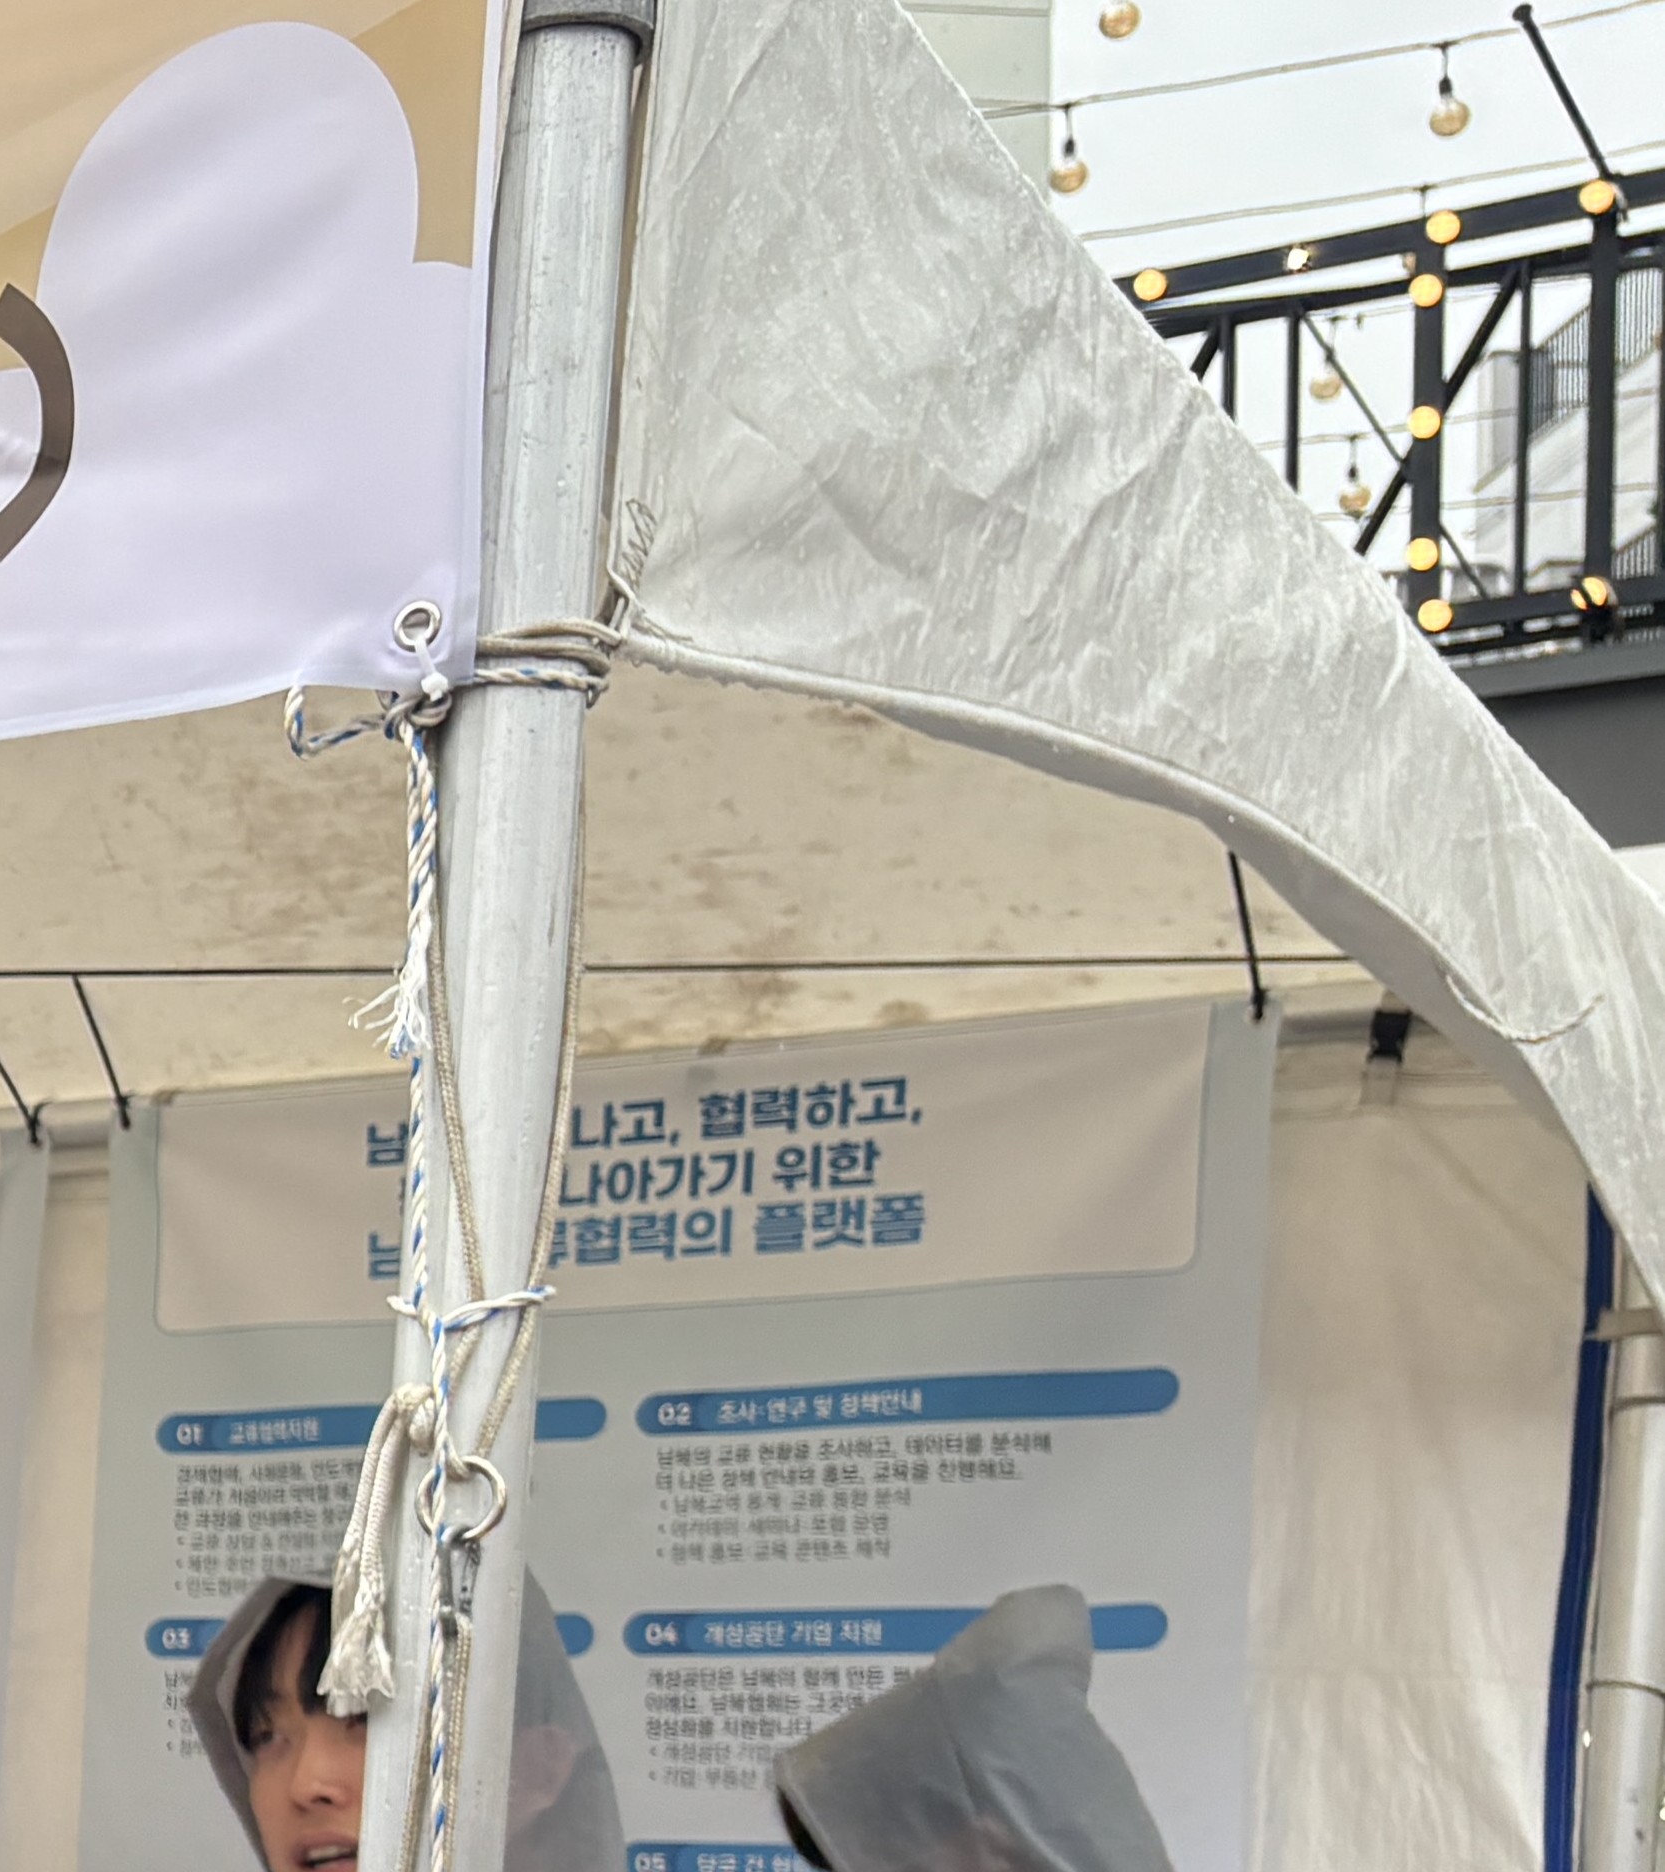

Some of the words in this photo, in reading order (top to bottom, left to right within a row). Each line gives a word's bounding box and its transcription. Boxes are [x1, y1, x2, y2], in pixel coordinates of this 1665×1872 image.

[568, 1097, 682, 1151] 나고,
[699, 1076, 923, 1139] 협력하고,
[558, 1149, 756, 1209] 나아가기
[771, 1138, 882, 1192] 위한
[752, 1192, 926, 1254] 플랫폼
[175, 1422, 205, 1447] 01
[657, 1402, 693, 1427] 02
[644, 1621, 679, 1646] 04
